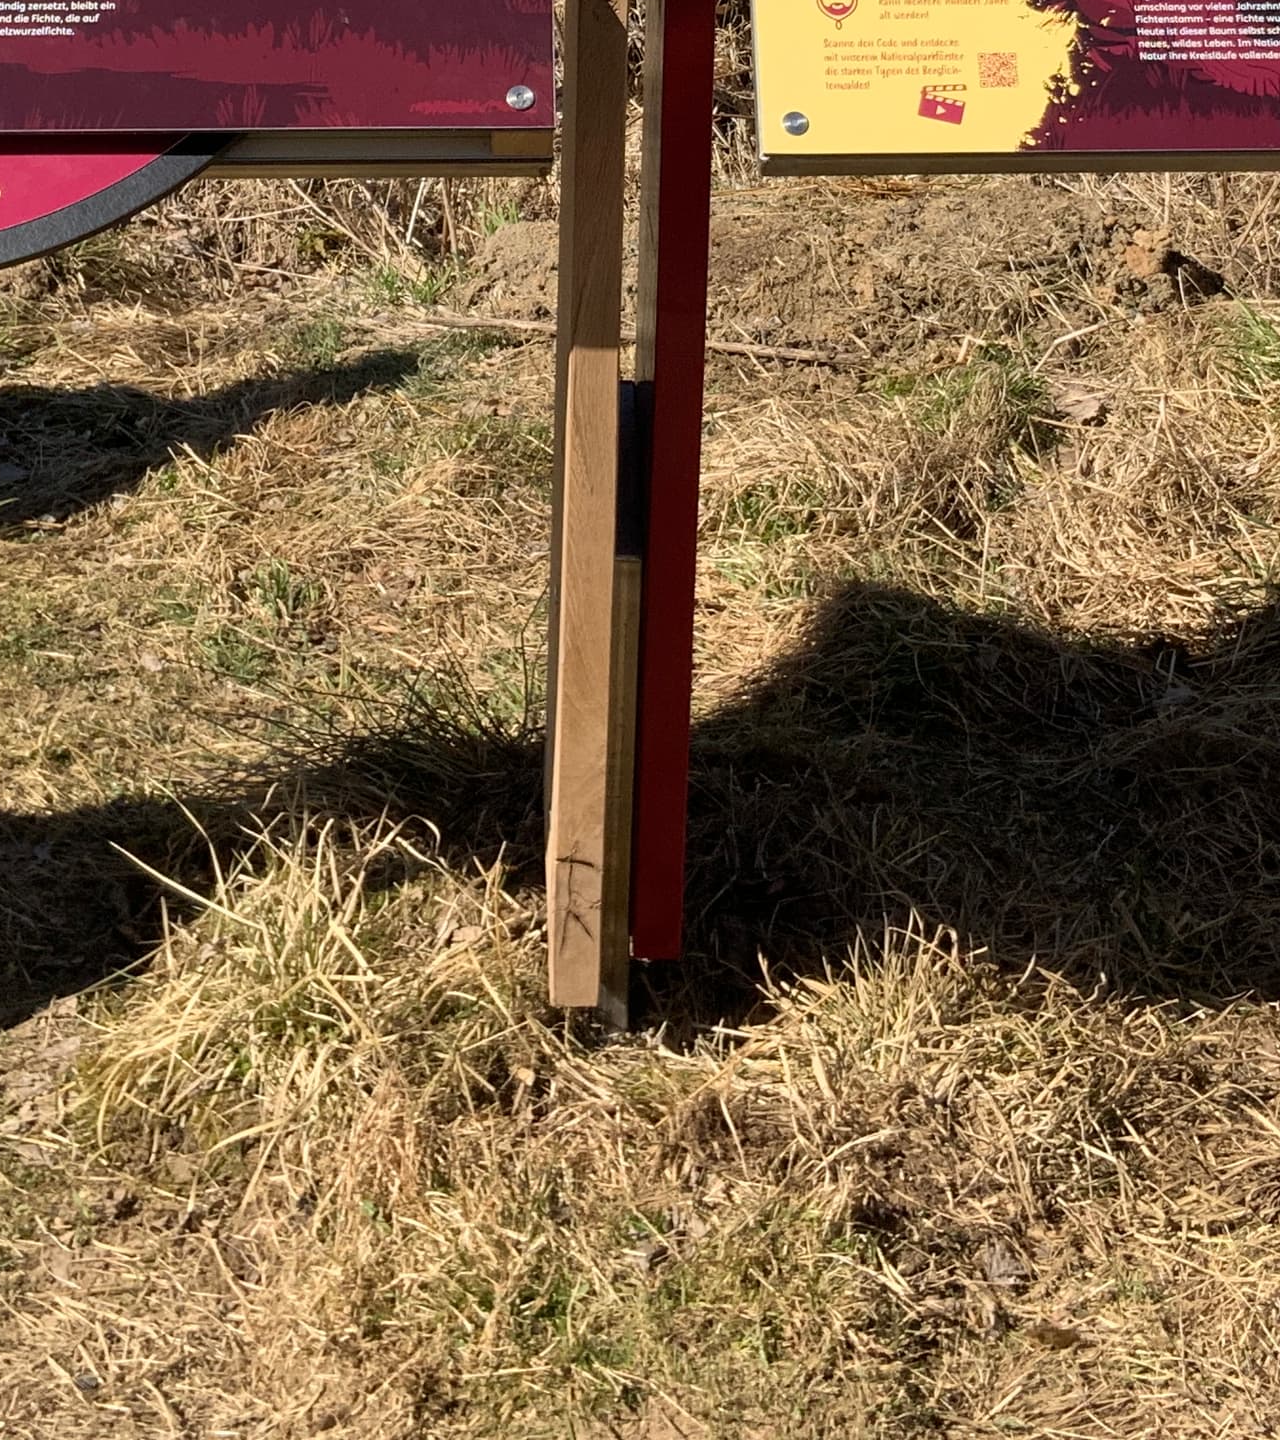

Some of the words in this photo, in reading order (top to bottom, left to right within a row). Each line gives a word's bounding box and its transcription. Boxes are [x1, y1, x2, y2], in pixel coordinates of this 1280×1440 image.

[1139, 52, 1168, 60] Natur
[1168, 52, 1188, 60] ihre
[1189, 51, 1238, 60] Kreisläufe
